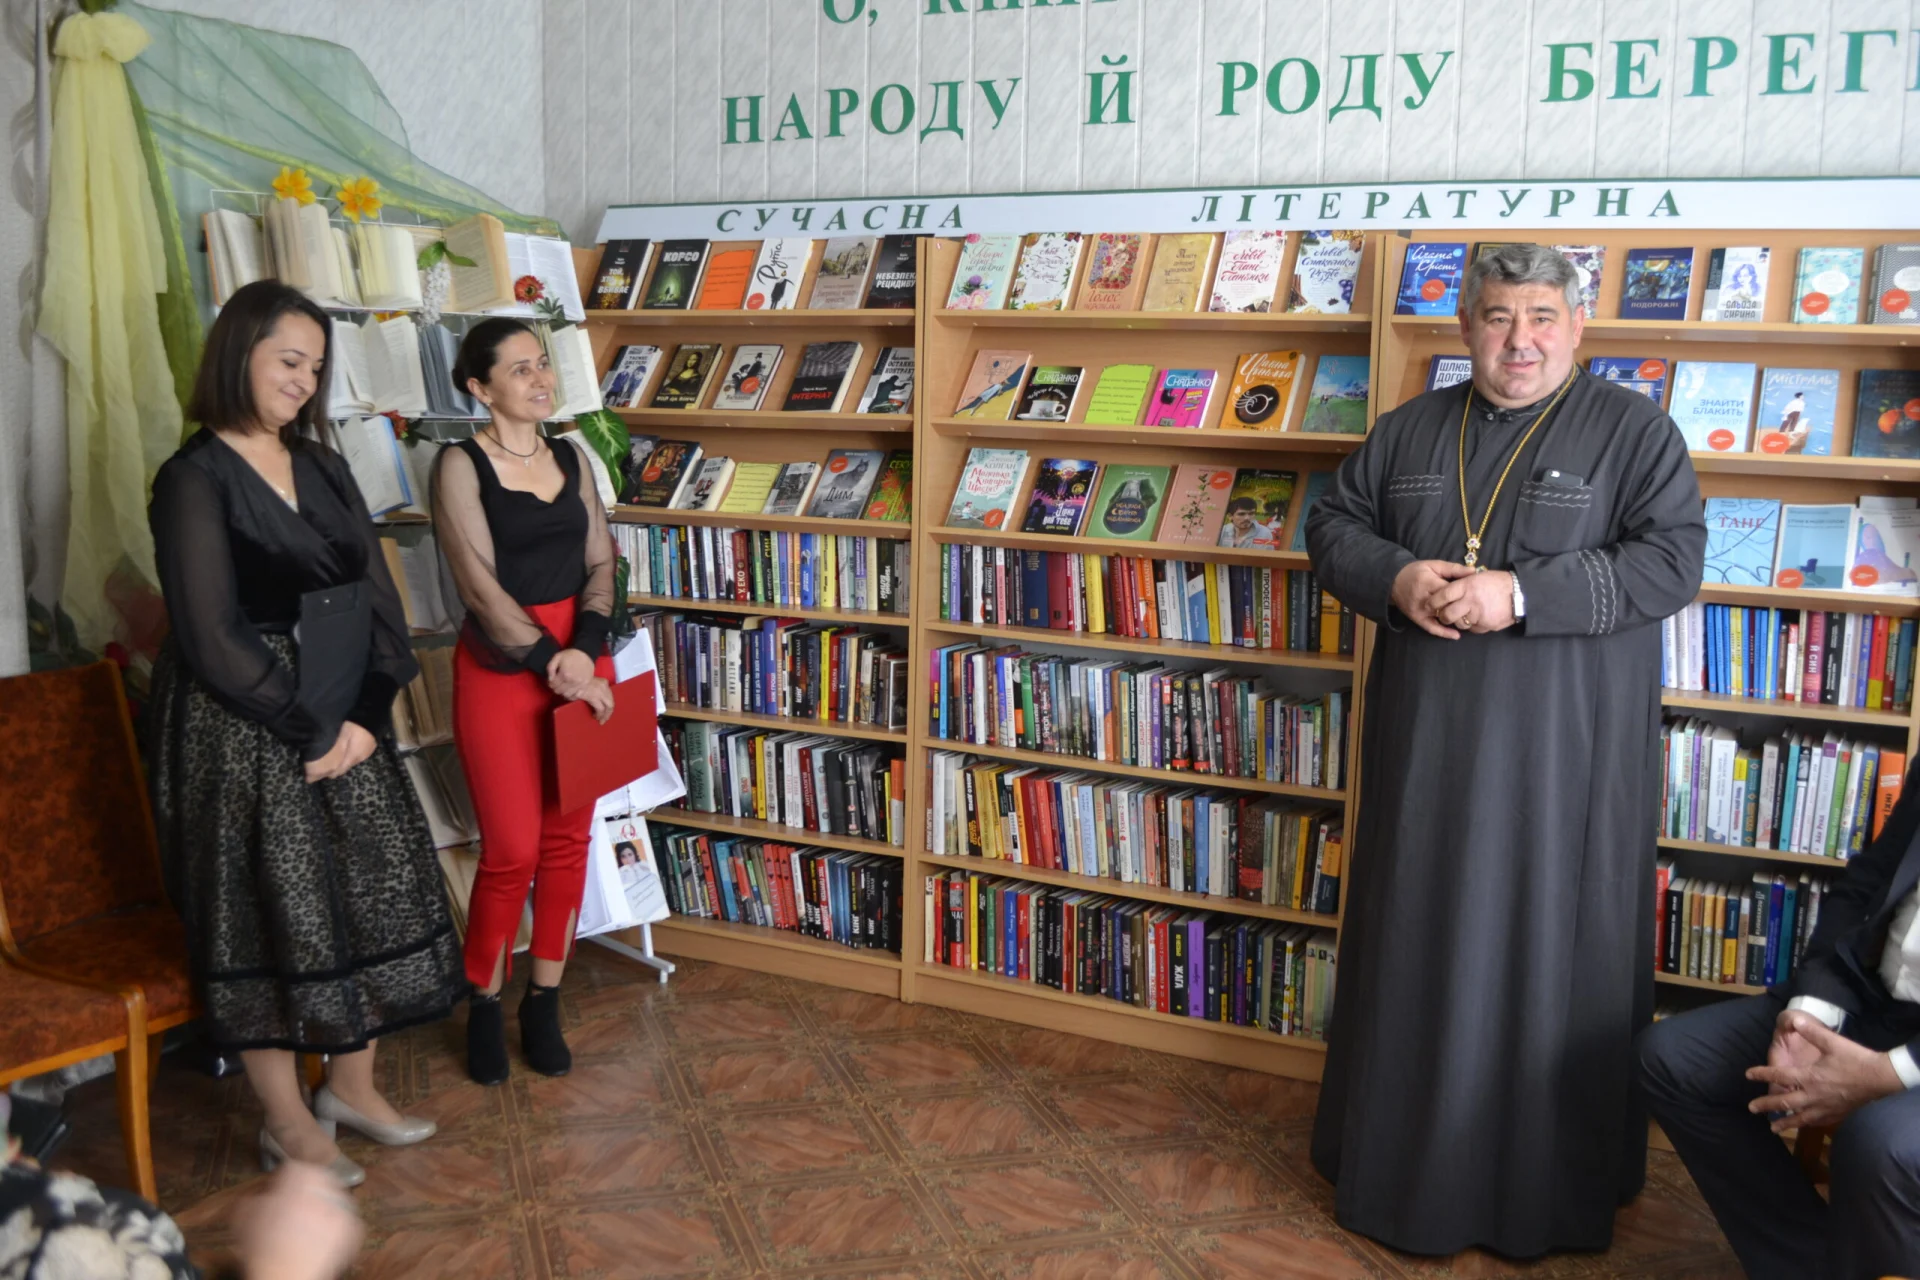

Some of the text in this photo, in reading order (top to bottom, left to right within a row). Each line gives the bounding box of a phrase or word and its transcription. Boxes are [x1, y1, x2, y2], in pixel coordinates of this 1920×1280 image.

[722, 77, 1022, 145] НАРОДУ
[1083, 54, 1138, 126] Й
[1214, 51, 1456, 124] РОДУ
[716, 188, 1681, 232] СУЧАСНА ЛІТЕРАТУРНА
[663, 251, 700, 262] КОРСО
[1412, 245, 1452, 260] Агата
[1415, 259, 1457, 276] Крісті
[1439, 361, 1471, 373] ШЛЮБ
[1035, 370, 1079, 384] Сняданко
[1166, 374, 1211, 388] Сняданко
[792, 391, 833, 400] ІНТЕРНАТ
[737, 571, 745, 587] ЕКО
[1809, 654, 1818, 673] СИН
[802, 772, 811, 806] АНТОЛОГІЯ
[1175, 965, 1183, 988] ЖАГА
